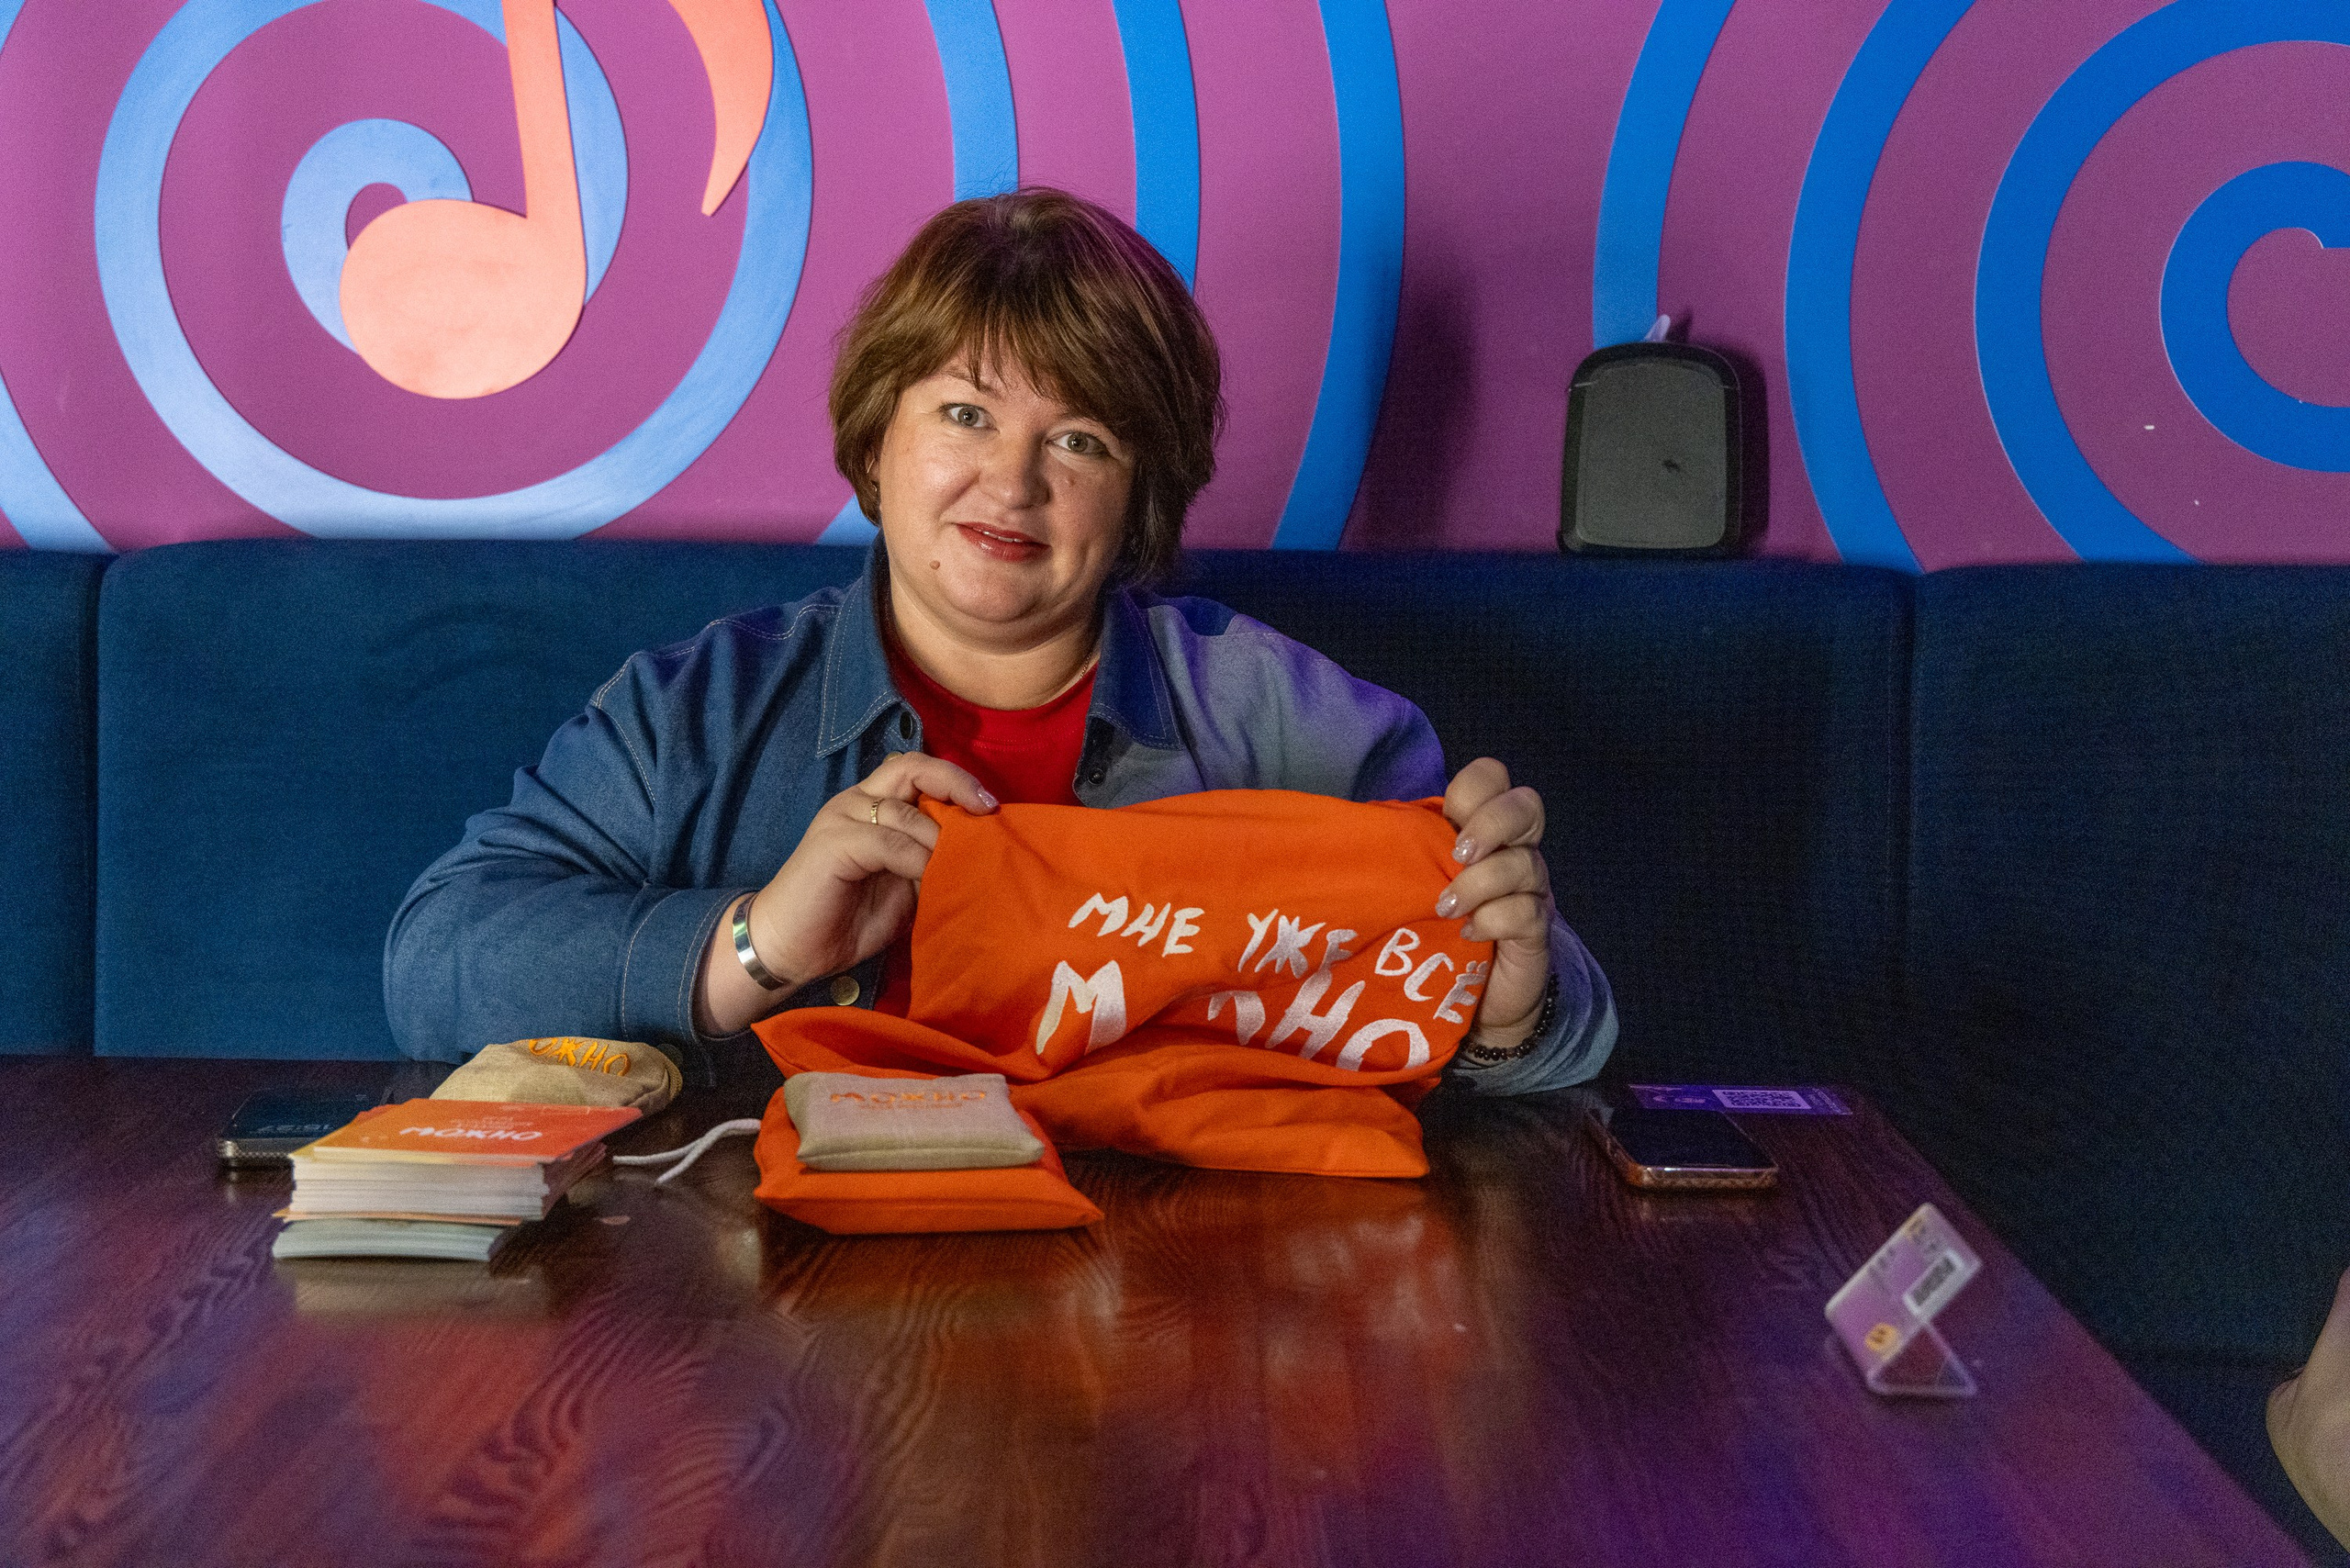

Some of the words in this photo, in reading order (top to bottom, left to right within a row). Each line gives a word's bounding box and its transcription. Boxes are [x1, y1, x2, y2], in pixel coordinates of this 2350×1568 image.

[1068, 891, 1205, 958] МНЕ
[1374, 927, 1489, 1025] ВСЁ
[528, 1036, 632, 1077] ОЖНО
[398, 1126, 543, 1141] МОЖНО
